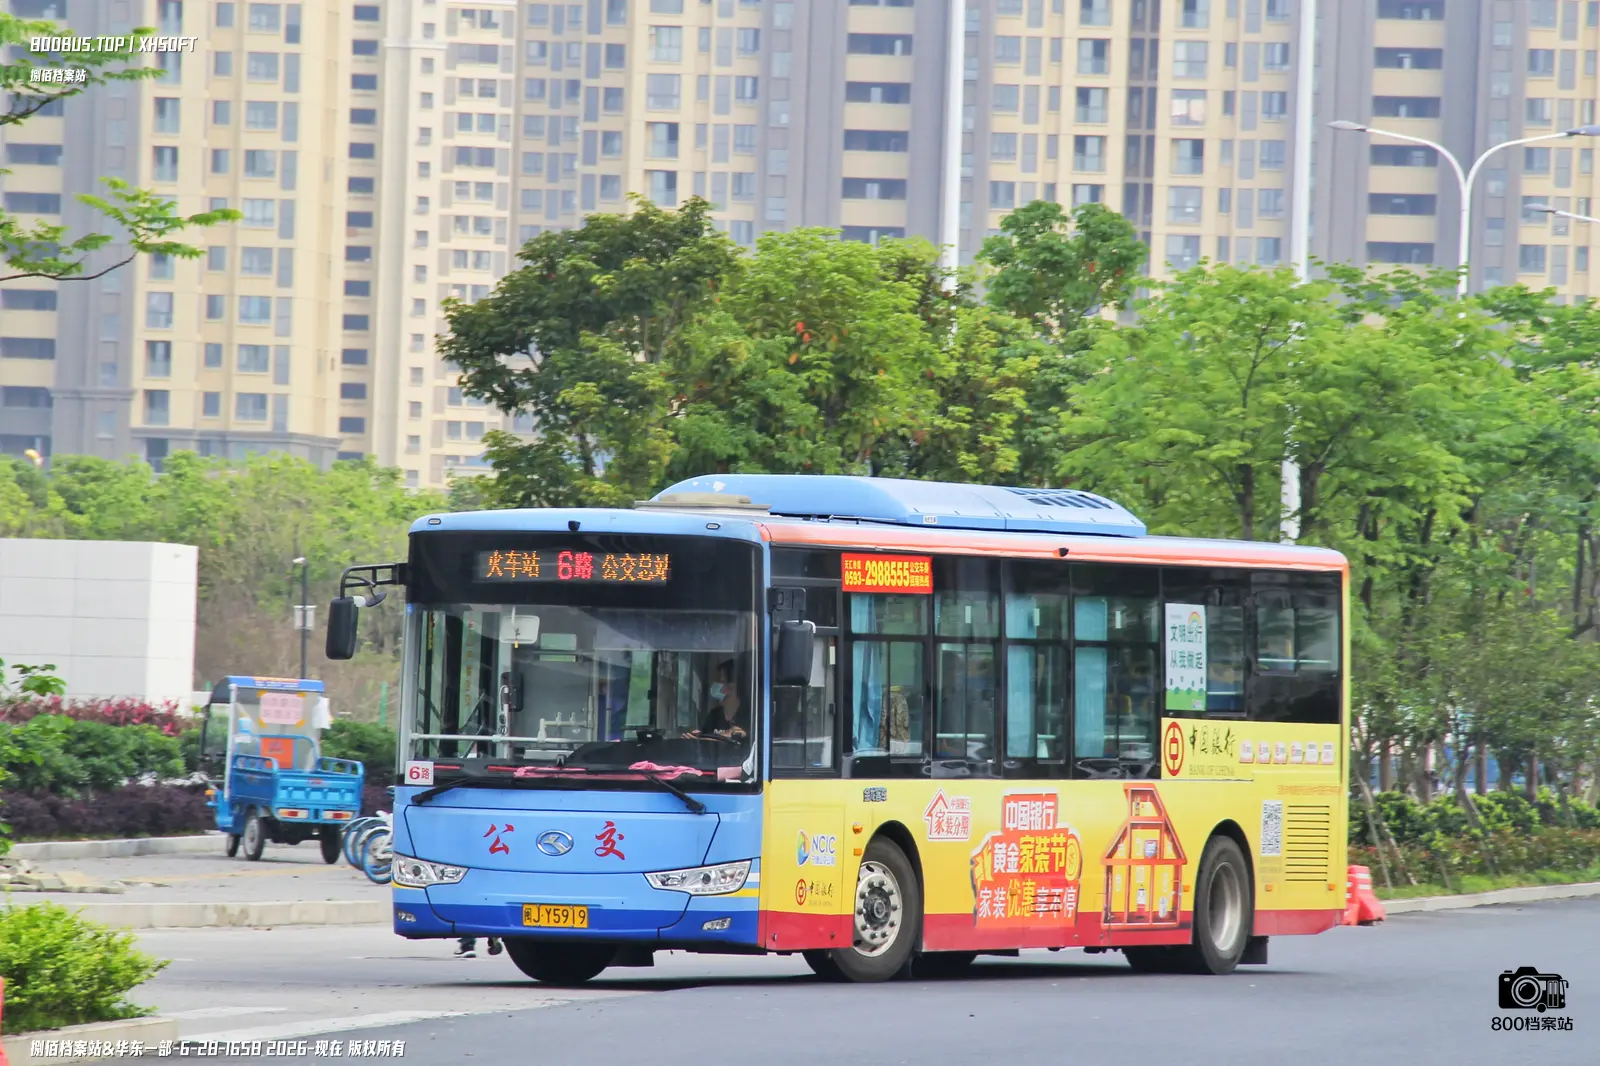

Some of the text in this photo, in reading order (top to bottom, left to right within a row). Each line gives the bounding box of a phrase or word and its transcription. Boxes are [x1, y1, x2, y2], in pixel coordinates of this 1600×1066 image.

[487, 550, 671, 581] 火车站 6路 公交总站
[1170, 624, 1203, 643] 文明出行
[1189, 724, 1236, 758] 中国银行
[409, 766, 430, 780] 6路
[935, 810, 969, 836] 家装分期
[1006, 801, 1055, 831] 中国银行
[483, 821, 625, 860] 公 交
[993, 833, 1066, 873] 黄金家装节
[978, 878, 1077, 918] 家装优惠享不停
